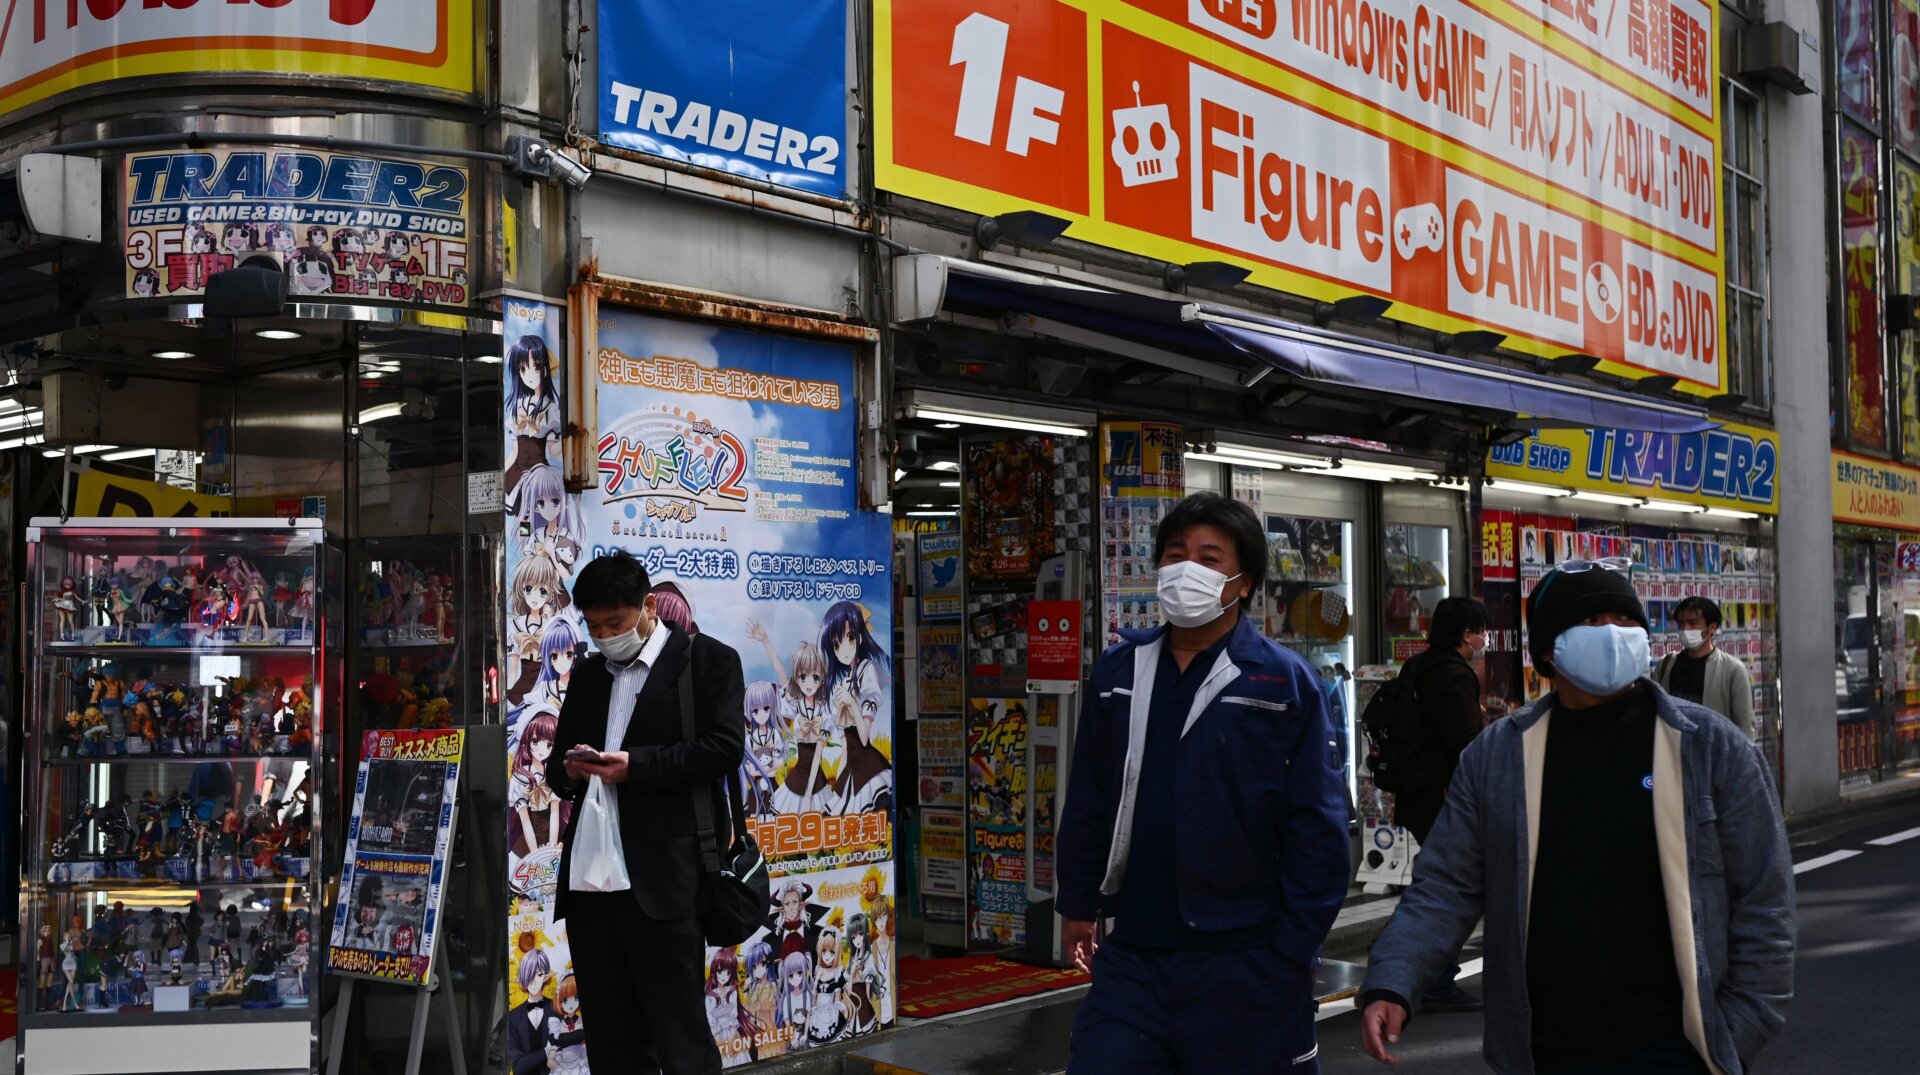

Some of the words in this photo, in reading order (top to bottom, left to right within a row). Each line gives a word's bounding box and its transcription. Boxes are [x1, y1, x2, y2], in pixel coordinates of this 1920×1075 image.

[949, 12, 1065, 157] 1F
[610, 80, 840, 176] TRADER2
[130, 152, 468, 215] TRADER2
[1200, 97, 1385, 264] Figure
[129, 206, 182, 225] USED
[408, 215, 465, 234] SHOP
[127, 228, 185, 270] 3F
[419, 238, 467, 279] 1F
[1452, 198, 1580, 325] GAME
[1627, 264, 1715, 365] BD&DVD
[599, 350, 841, 410] 神にも悪魔にも狙われている男
[1114, 464, 1142, 477] US
[1528, 444, 1572, 473] SHOP
[1585, 427, 1777, 504] TRADER2
[380, 736, 396, 747] BEST
[394, 734, 460, 760] オススメ商品
[513, 916, 546, 933] Navel
[733, 1037, 751, 1052] ON
